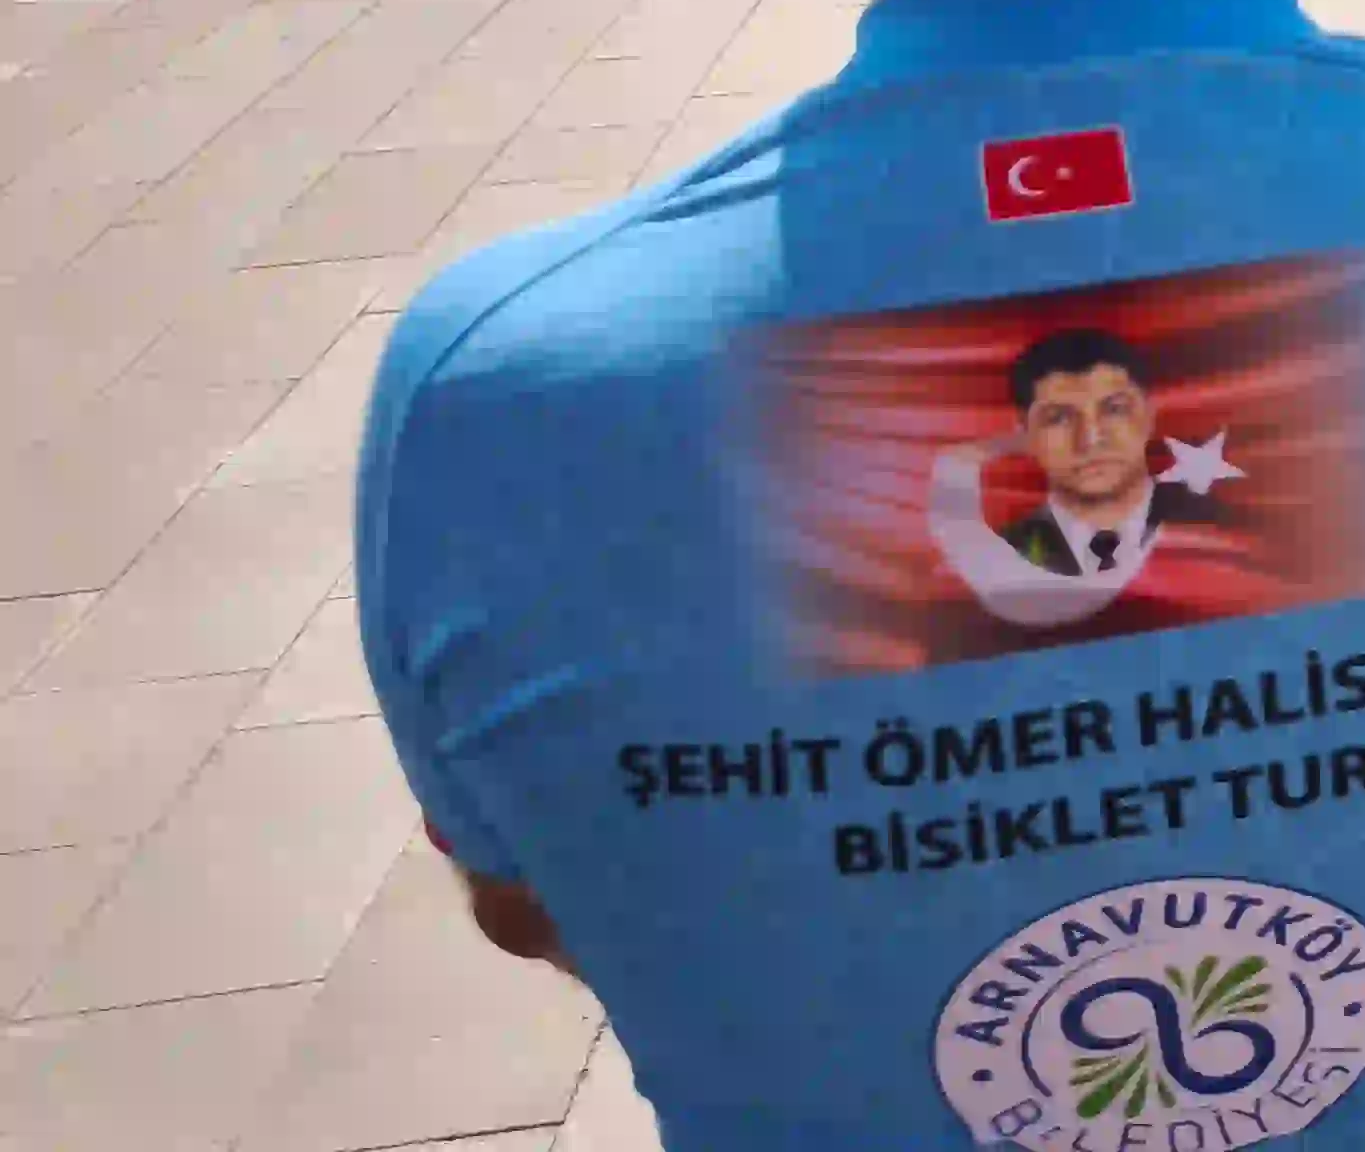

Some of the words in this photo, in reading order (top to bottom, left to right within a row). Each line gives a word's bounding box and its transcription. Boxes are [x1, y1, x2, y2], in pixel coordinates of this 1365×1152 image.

[616, 738, 840, 808] ŞEHİT
[862, 696, 1114, 787] ÖMER
[832, 774, 1195, 878] BİSİKLET
